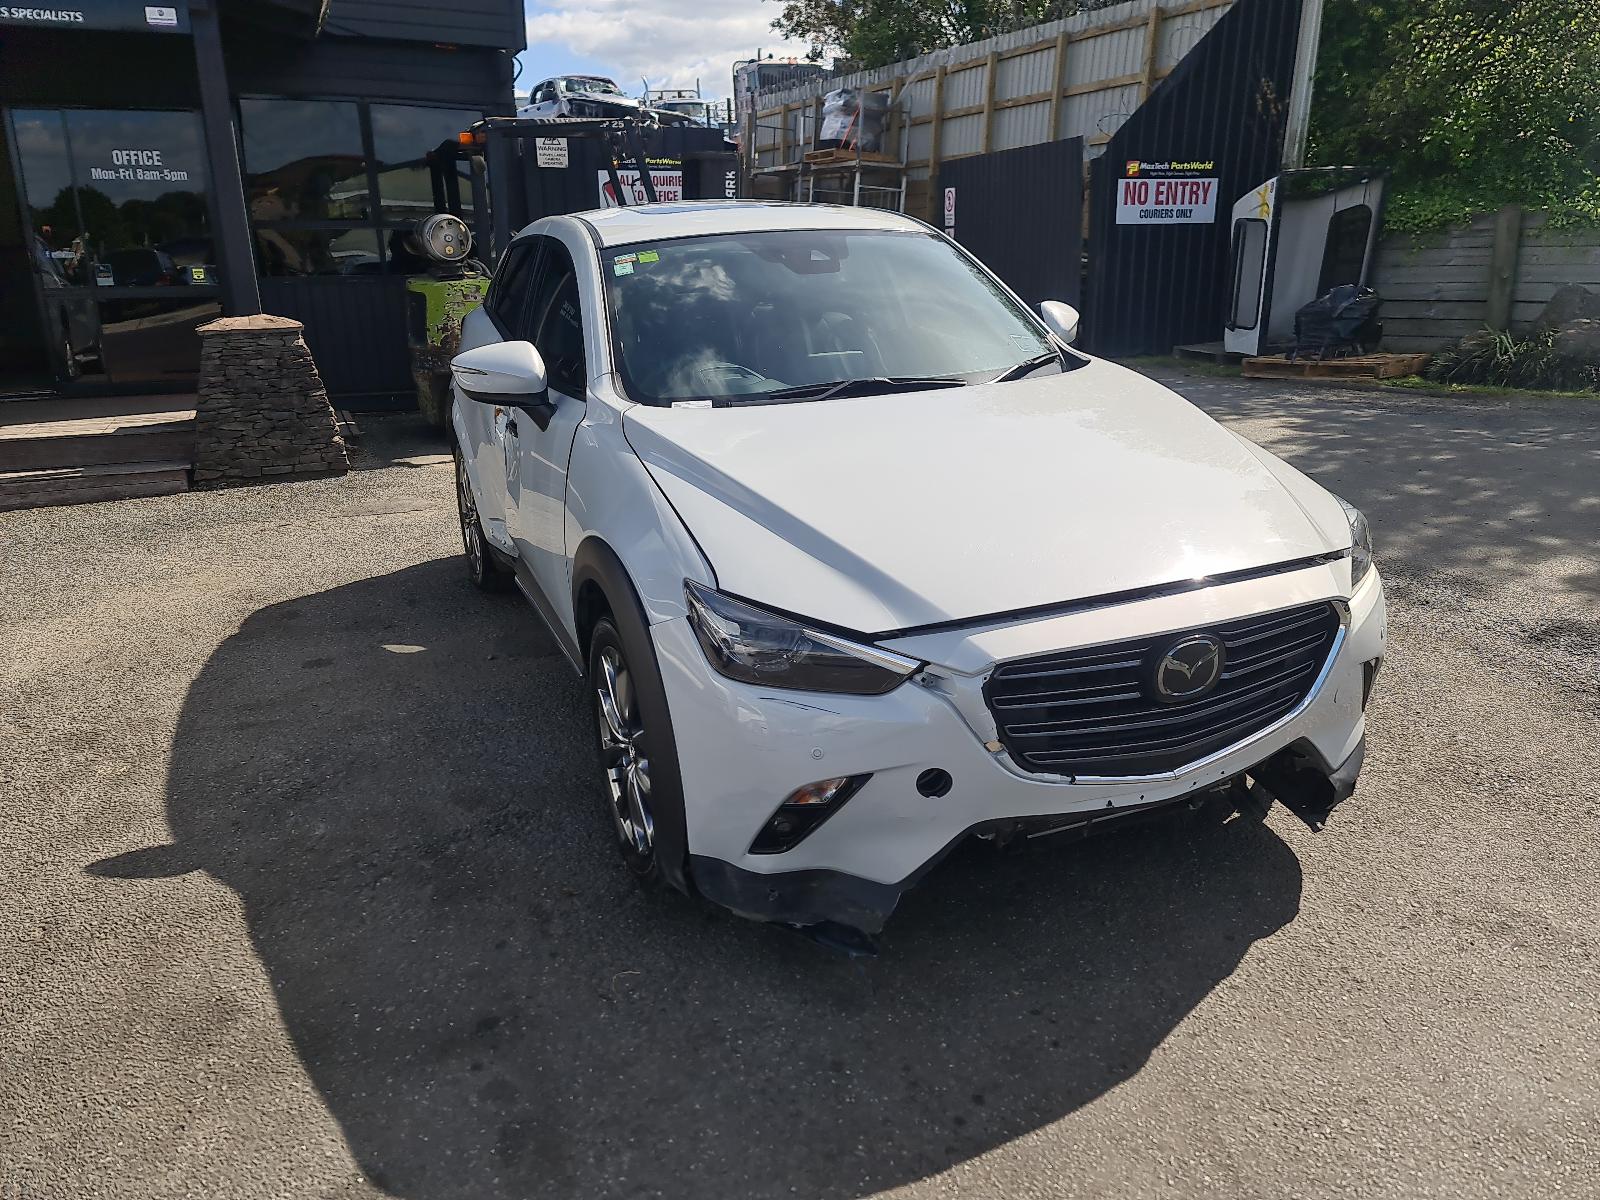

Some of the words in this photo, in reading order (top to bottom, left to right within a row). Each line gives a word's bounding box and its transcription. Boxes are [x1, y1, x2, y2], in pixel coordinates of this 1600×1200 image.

[11, 7, 84, 22] SPECIALISTS
[111, 149, 163, 166] OFFICE
[1140, 161, 1170, 170] MaxTech
[1170, 160, 1214, 170] PartsWorld
[90, 167, 135, 180] Mon-Fri
[136, 168, 188, 182] 8am-5pm
[1123, 181, 1149, 206] NO
[1154, 181, 1212, 206] ENTRY
[1139, 208, 1174, 219] COURIERS
[1175, 208, 1193, 219] ONLY
